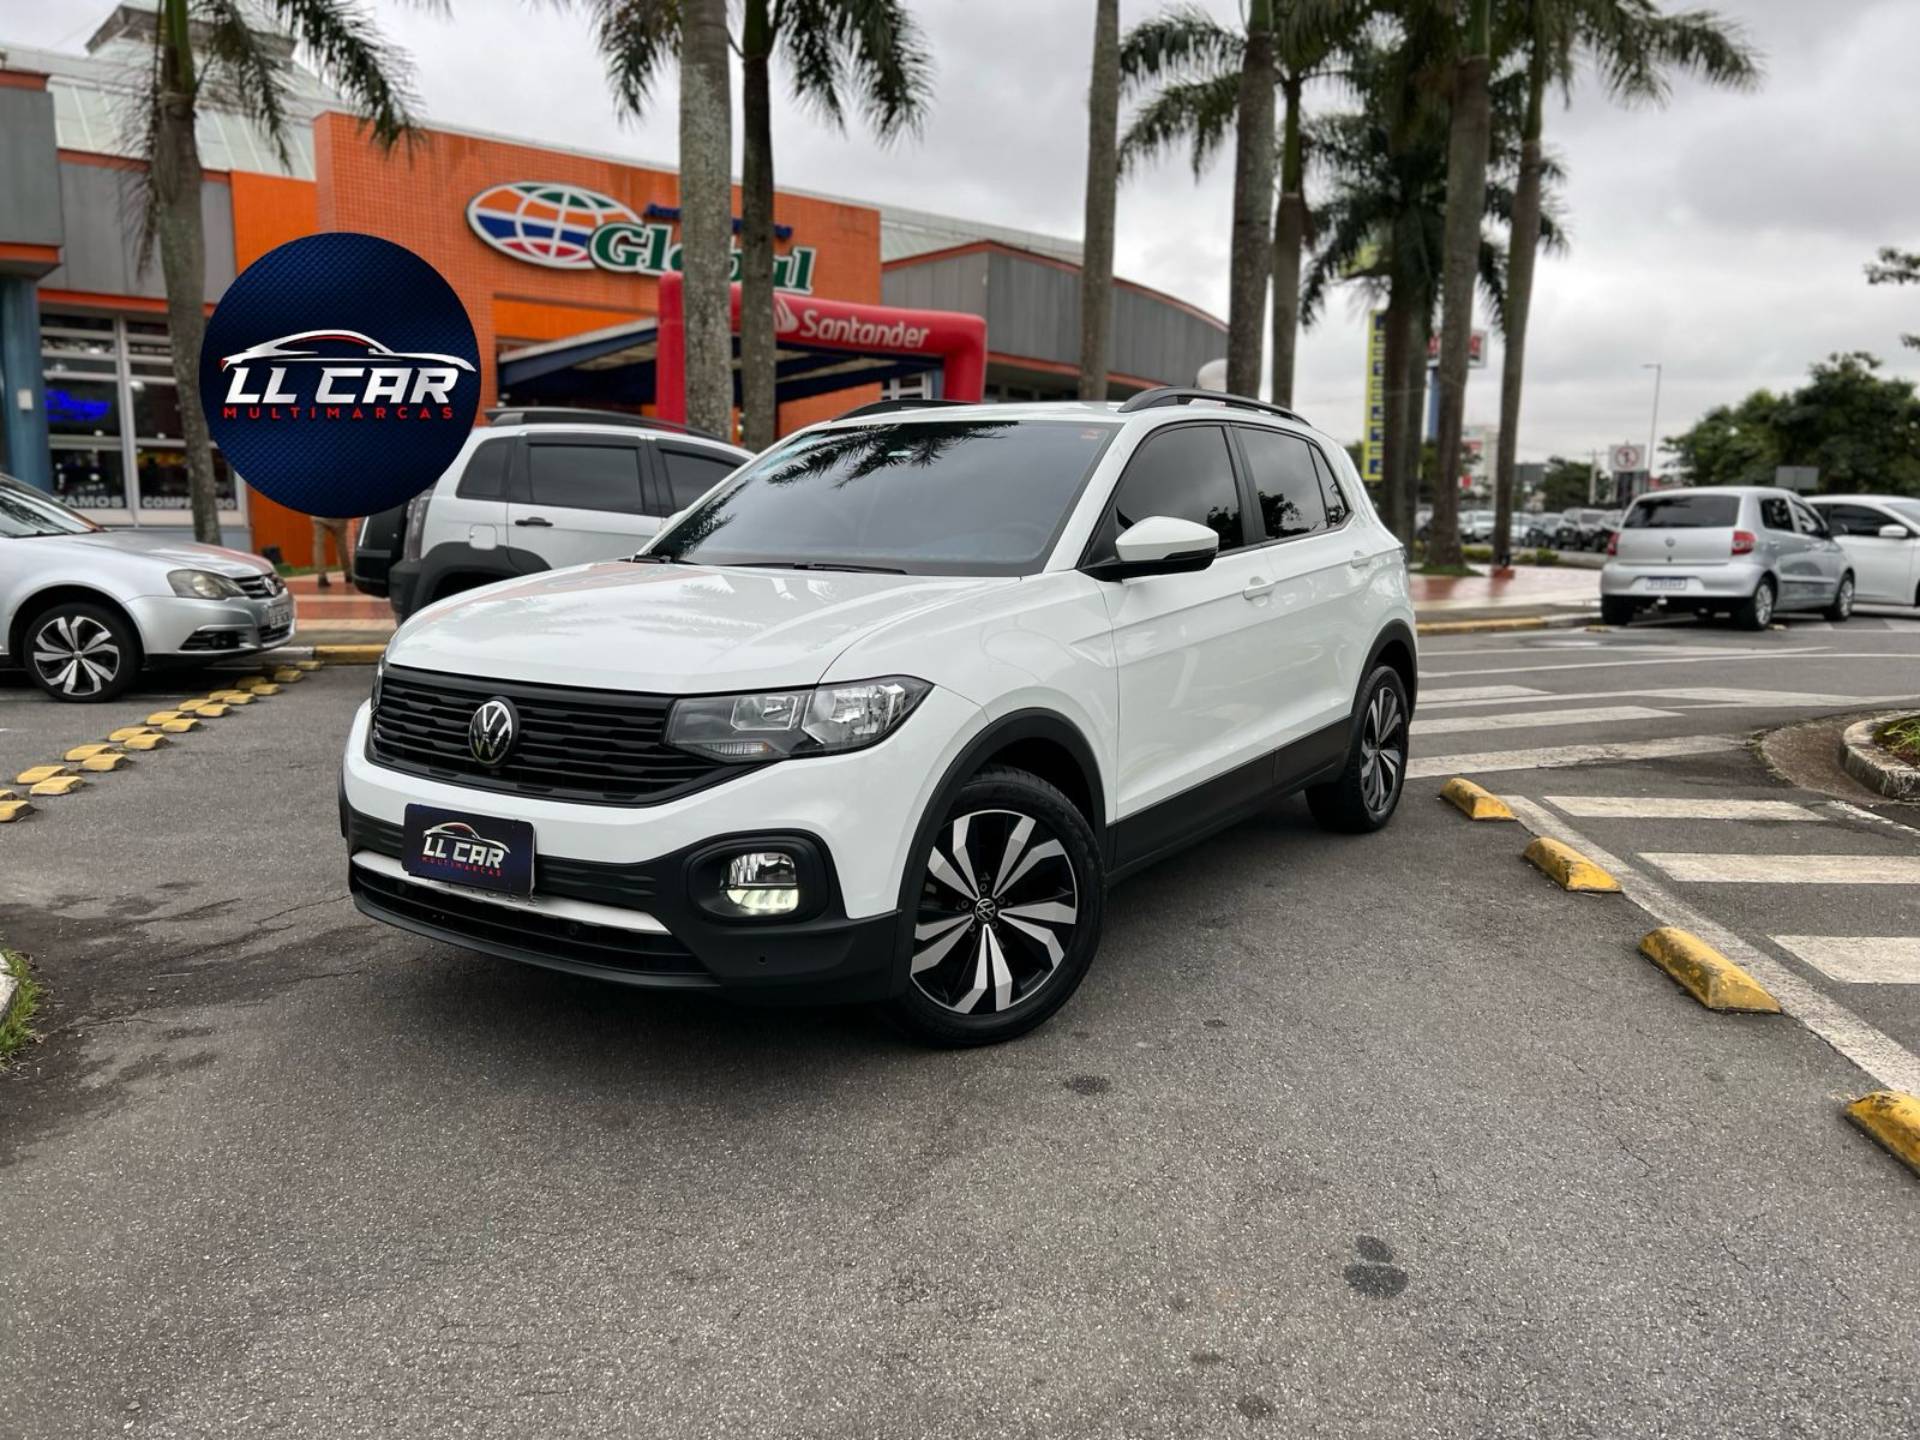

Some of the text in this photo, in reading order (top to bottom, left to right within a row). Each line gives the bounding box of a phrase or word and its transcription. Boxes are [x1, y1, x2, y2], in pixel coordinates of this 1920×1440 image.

[801, 309, 930, 348] Santander
[422, 836, 505, 869] LL CAR
